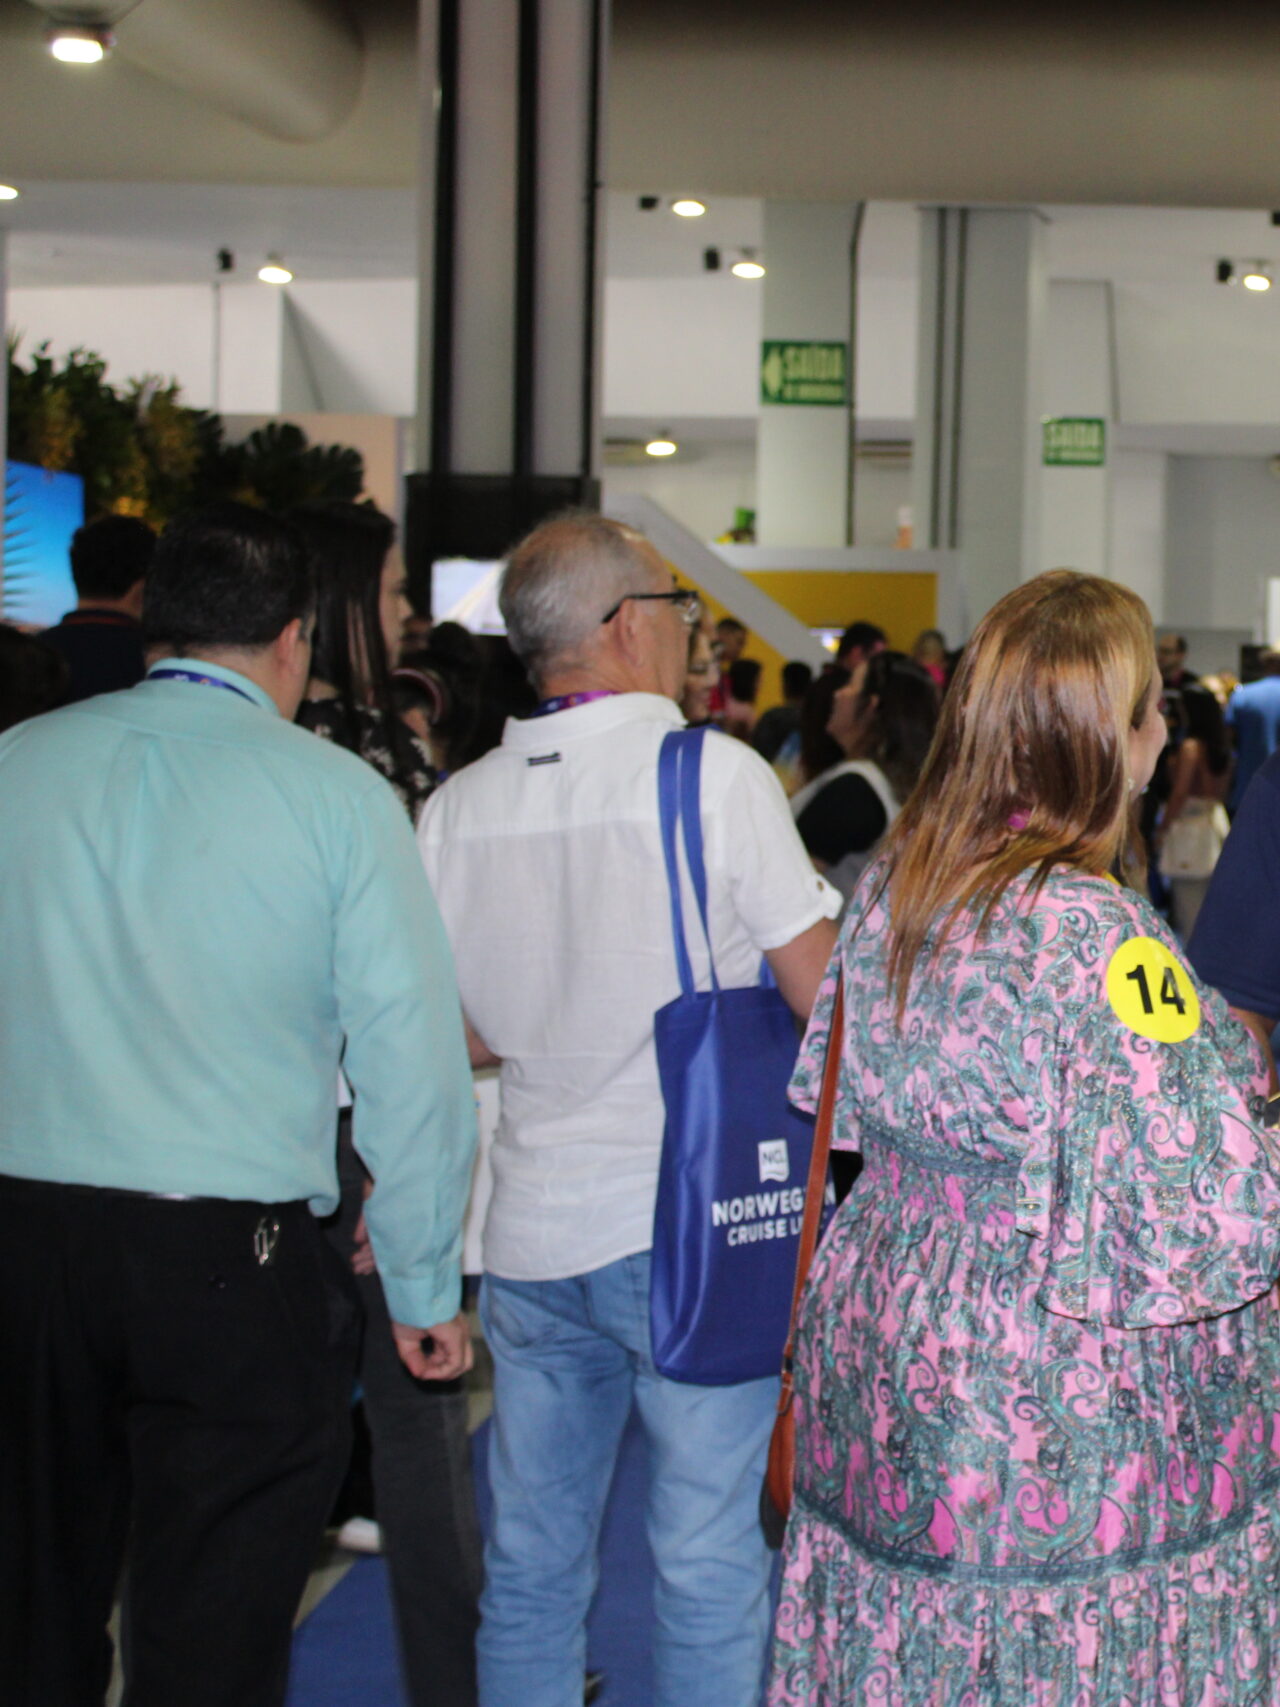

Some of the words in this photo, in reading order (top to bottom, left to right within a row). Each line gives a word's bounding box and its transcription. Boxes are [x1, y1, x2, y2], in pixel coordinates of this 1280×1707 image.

[1126, 964, 1186, 1014] 14
[711, 1181, 837, 1227] NORWEGN
[727, 1217, 787, 1247] CRUISE
